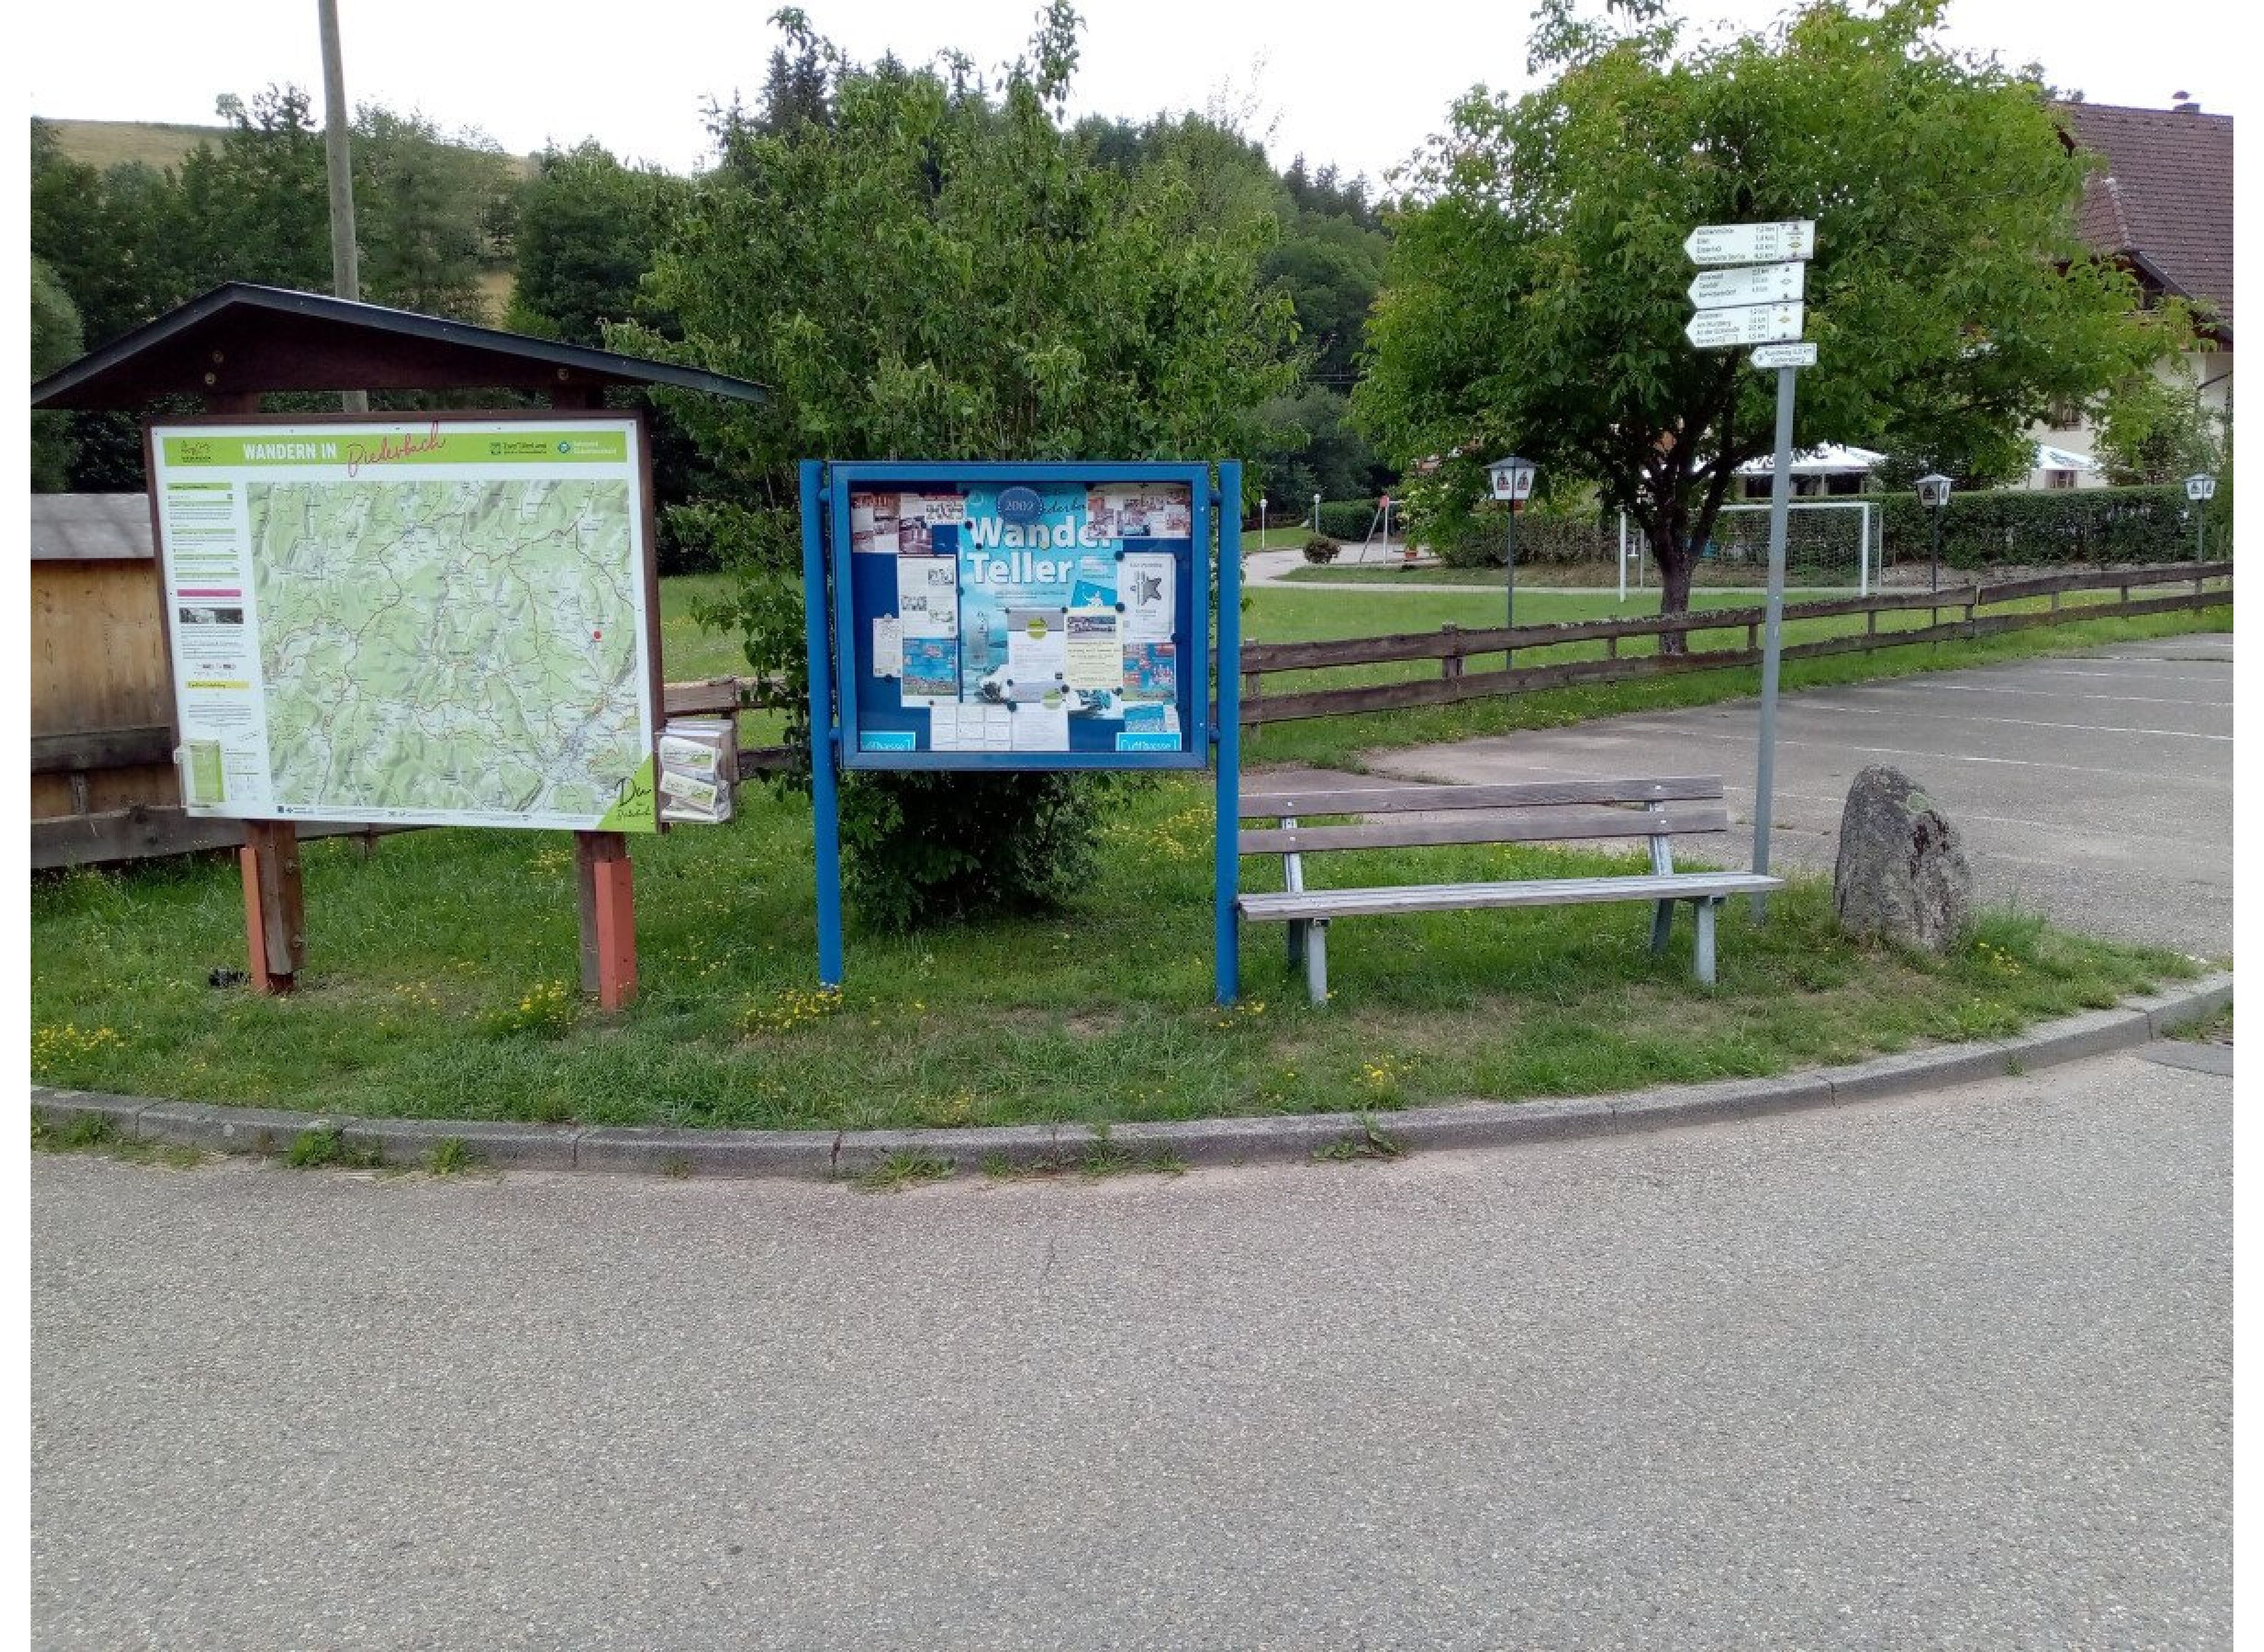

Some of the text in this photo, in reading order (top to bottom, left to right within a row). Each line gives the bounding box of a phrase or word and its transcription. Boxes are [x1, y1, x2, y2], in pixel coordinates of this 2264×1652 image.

[244, 442, 316, 460] WANDERN
[321, 442, 337, 459] IN
[970, 516, 1112, 546] Wande
[967, 552, 1073, 584] Teller
